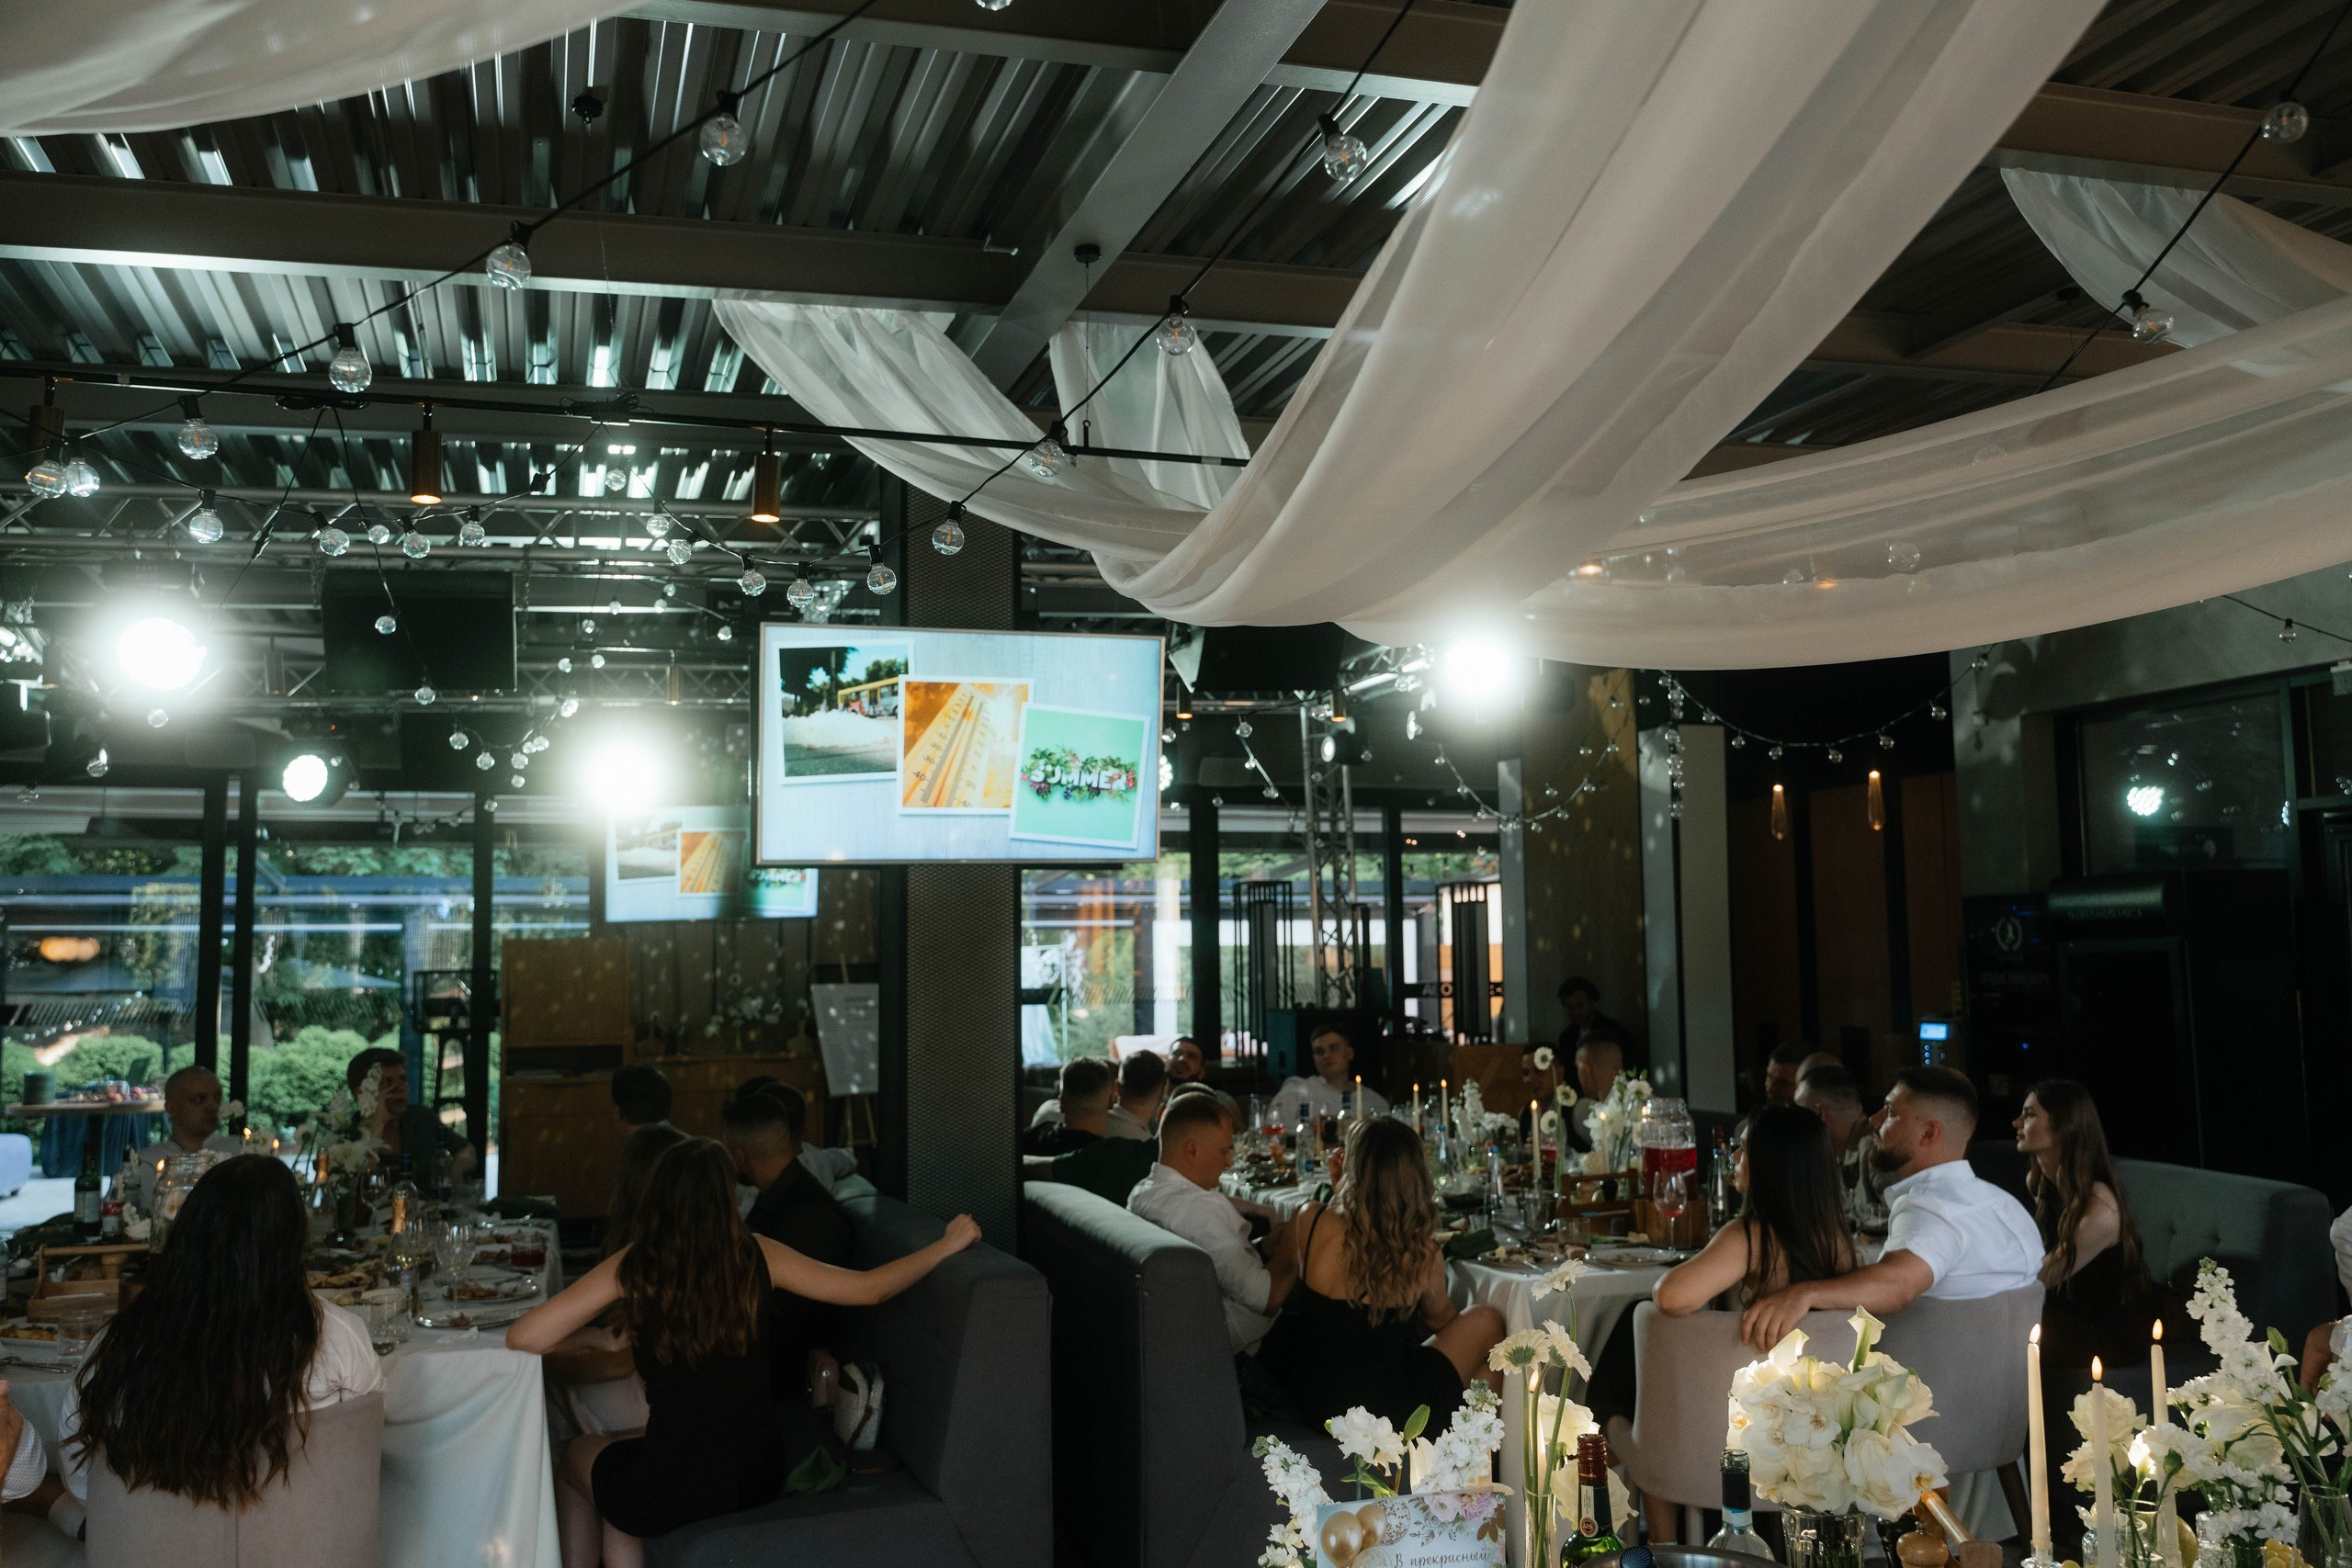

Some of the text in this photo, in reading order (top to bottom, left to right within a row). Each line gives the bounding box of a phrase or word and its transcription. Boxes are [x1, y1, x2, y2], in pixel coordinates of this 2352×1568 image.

[1030, 763, 1127, 790] SUMMER
[1394, 1547, 1490, 1568] В прекрасный
